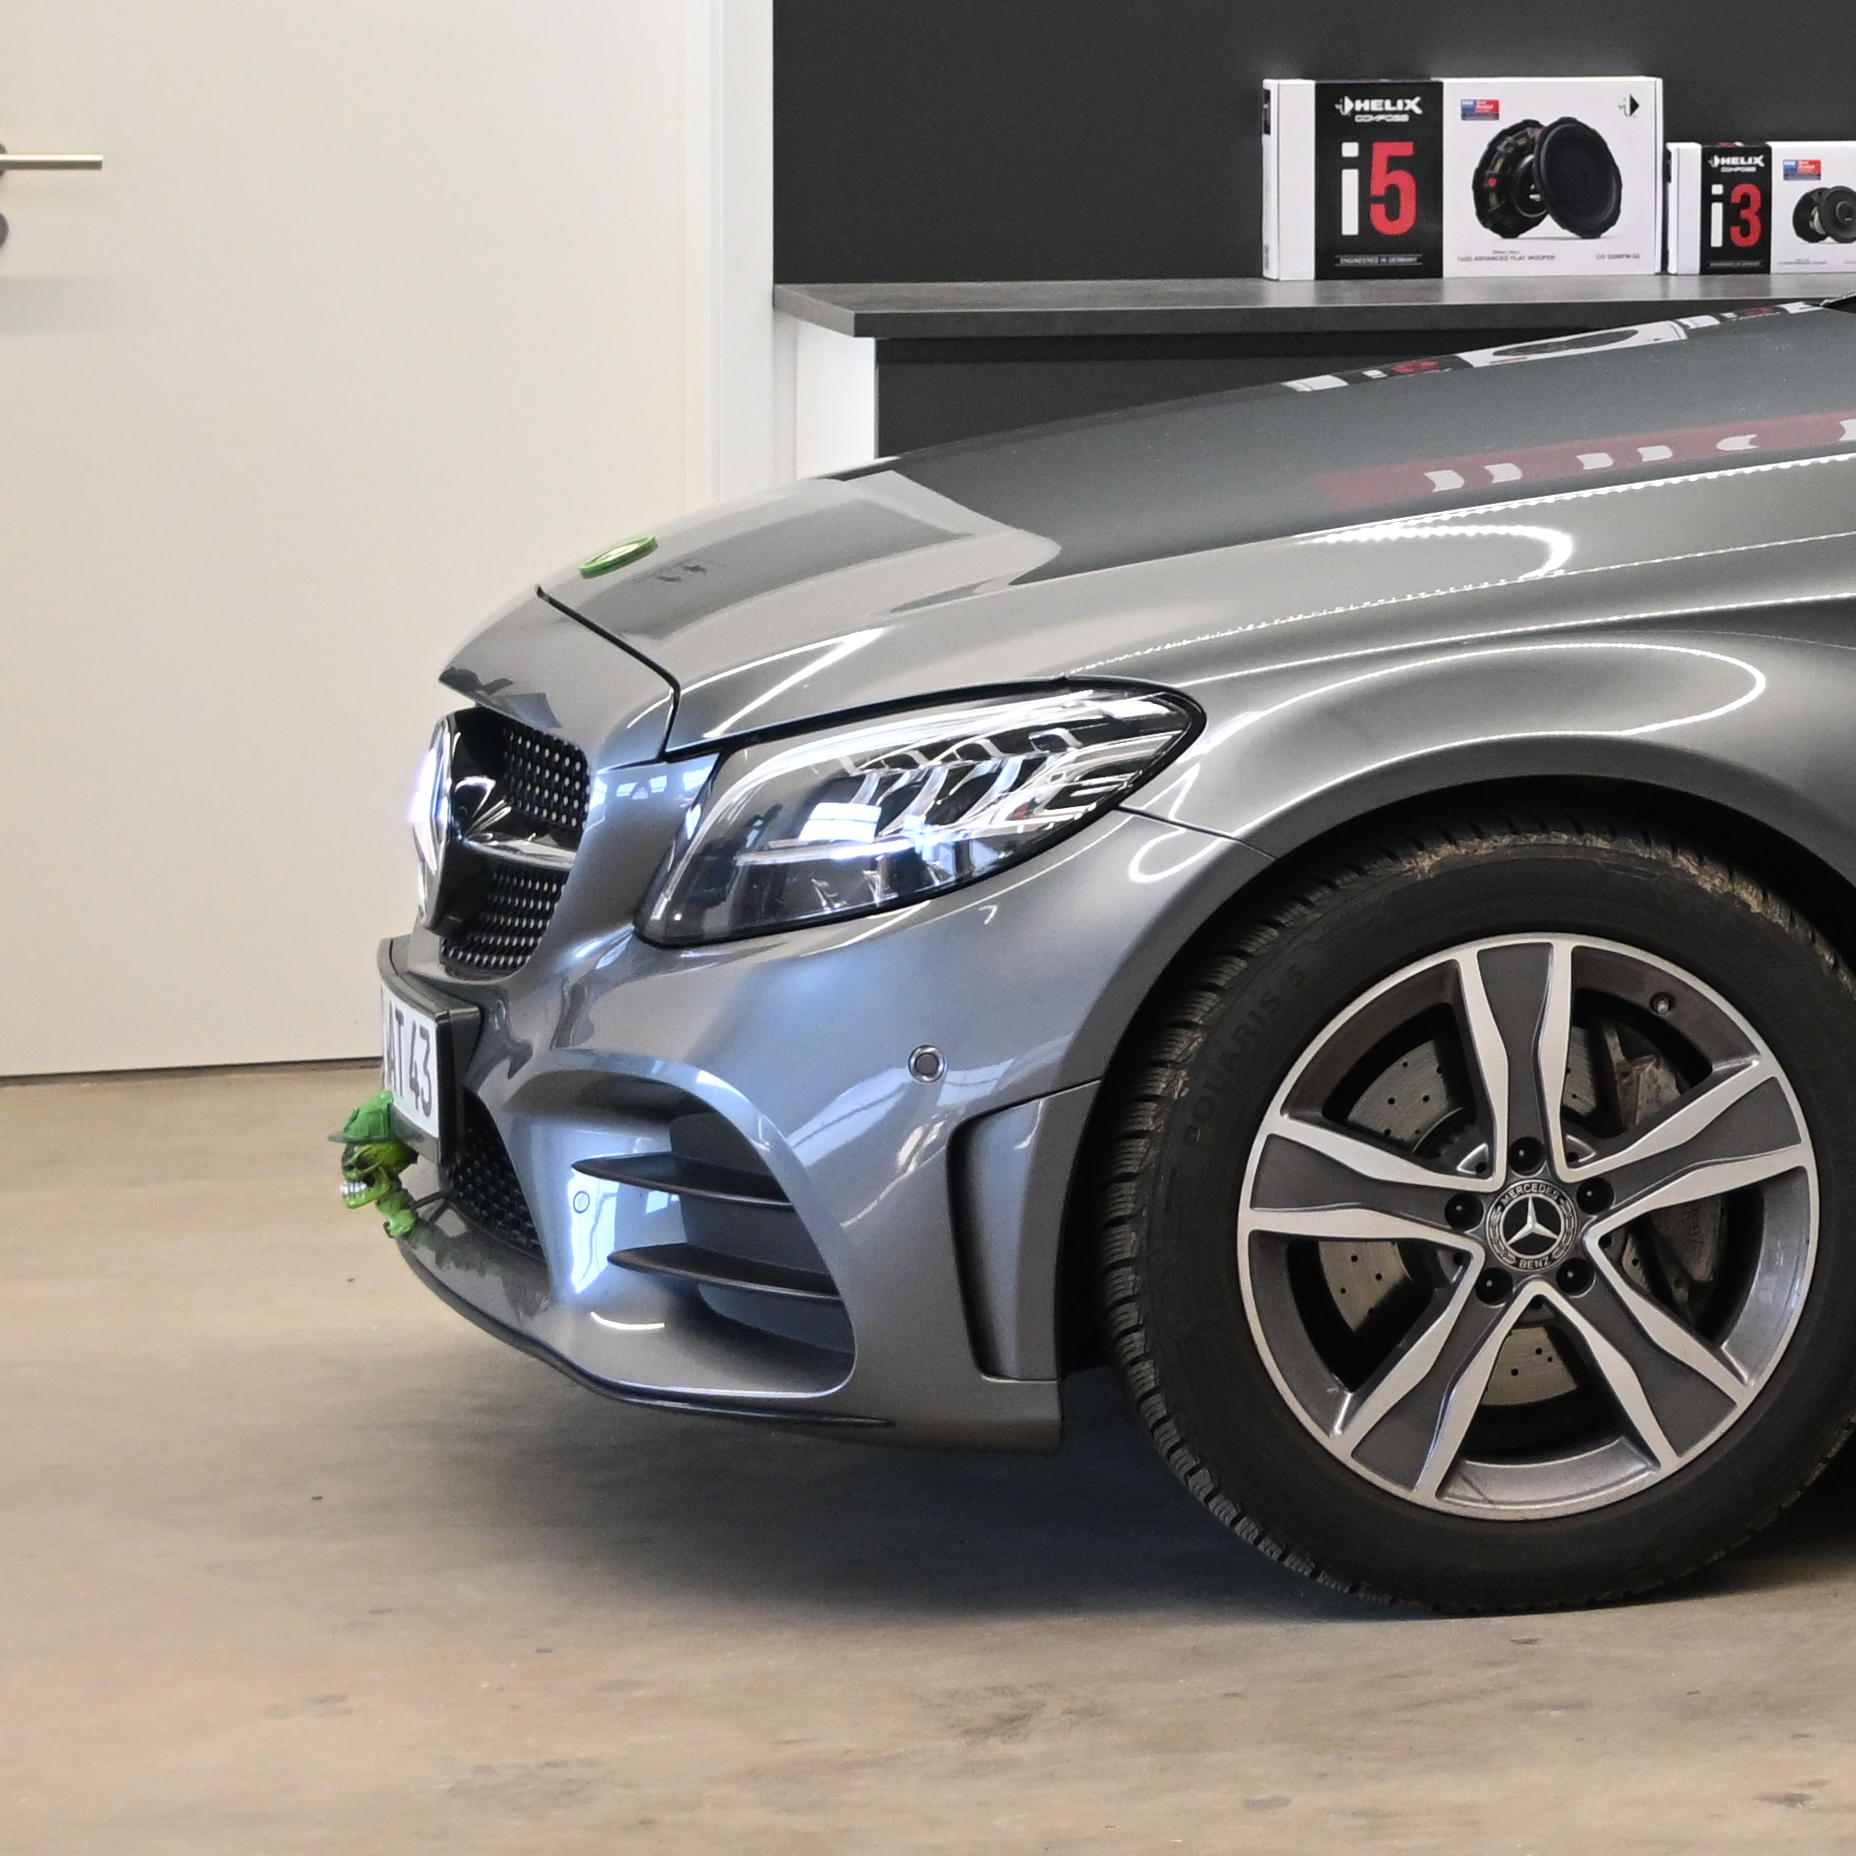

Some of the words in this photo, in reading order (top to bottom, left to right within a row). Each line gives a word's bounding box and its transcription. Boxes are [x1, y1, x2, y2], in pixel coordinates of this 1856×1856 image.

[1354, 96, 1423, 115] HELIX
[1720, 155, 1765, 167] HELIX
[1341, 141, 1417, 235] i5
[1710, 183, 1762, 248] i3
[409, 1019, 432, 1118] 43
[1184, 992, 1283, 1146] POLARIS
[1499, 1183, 1561, 1206] MERCEDES
[1518, 1256, 1552, 1269] BENZ
